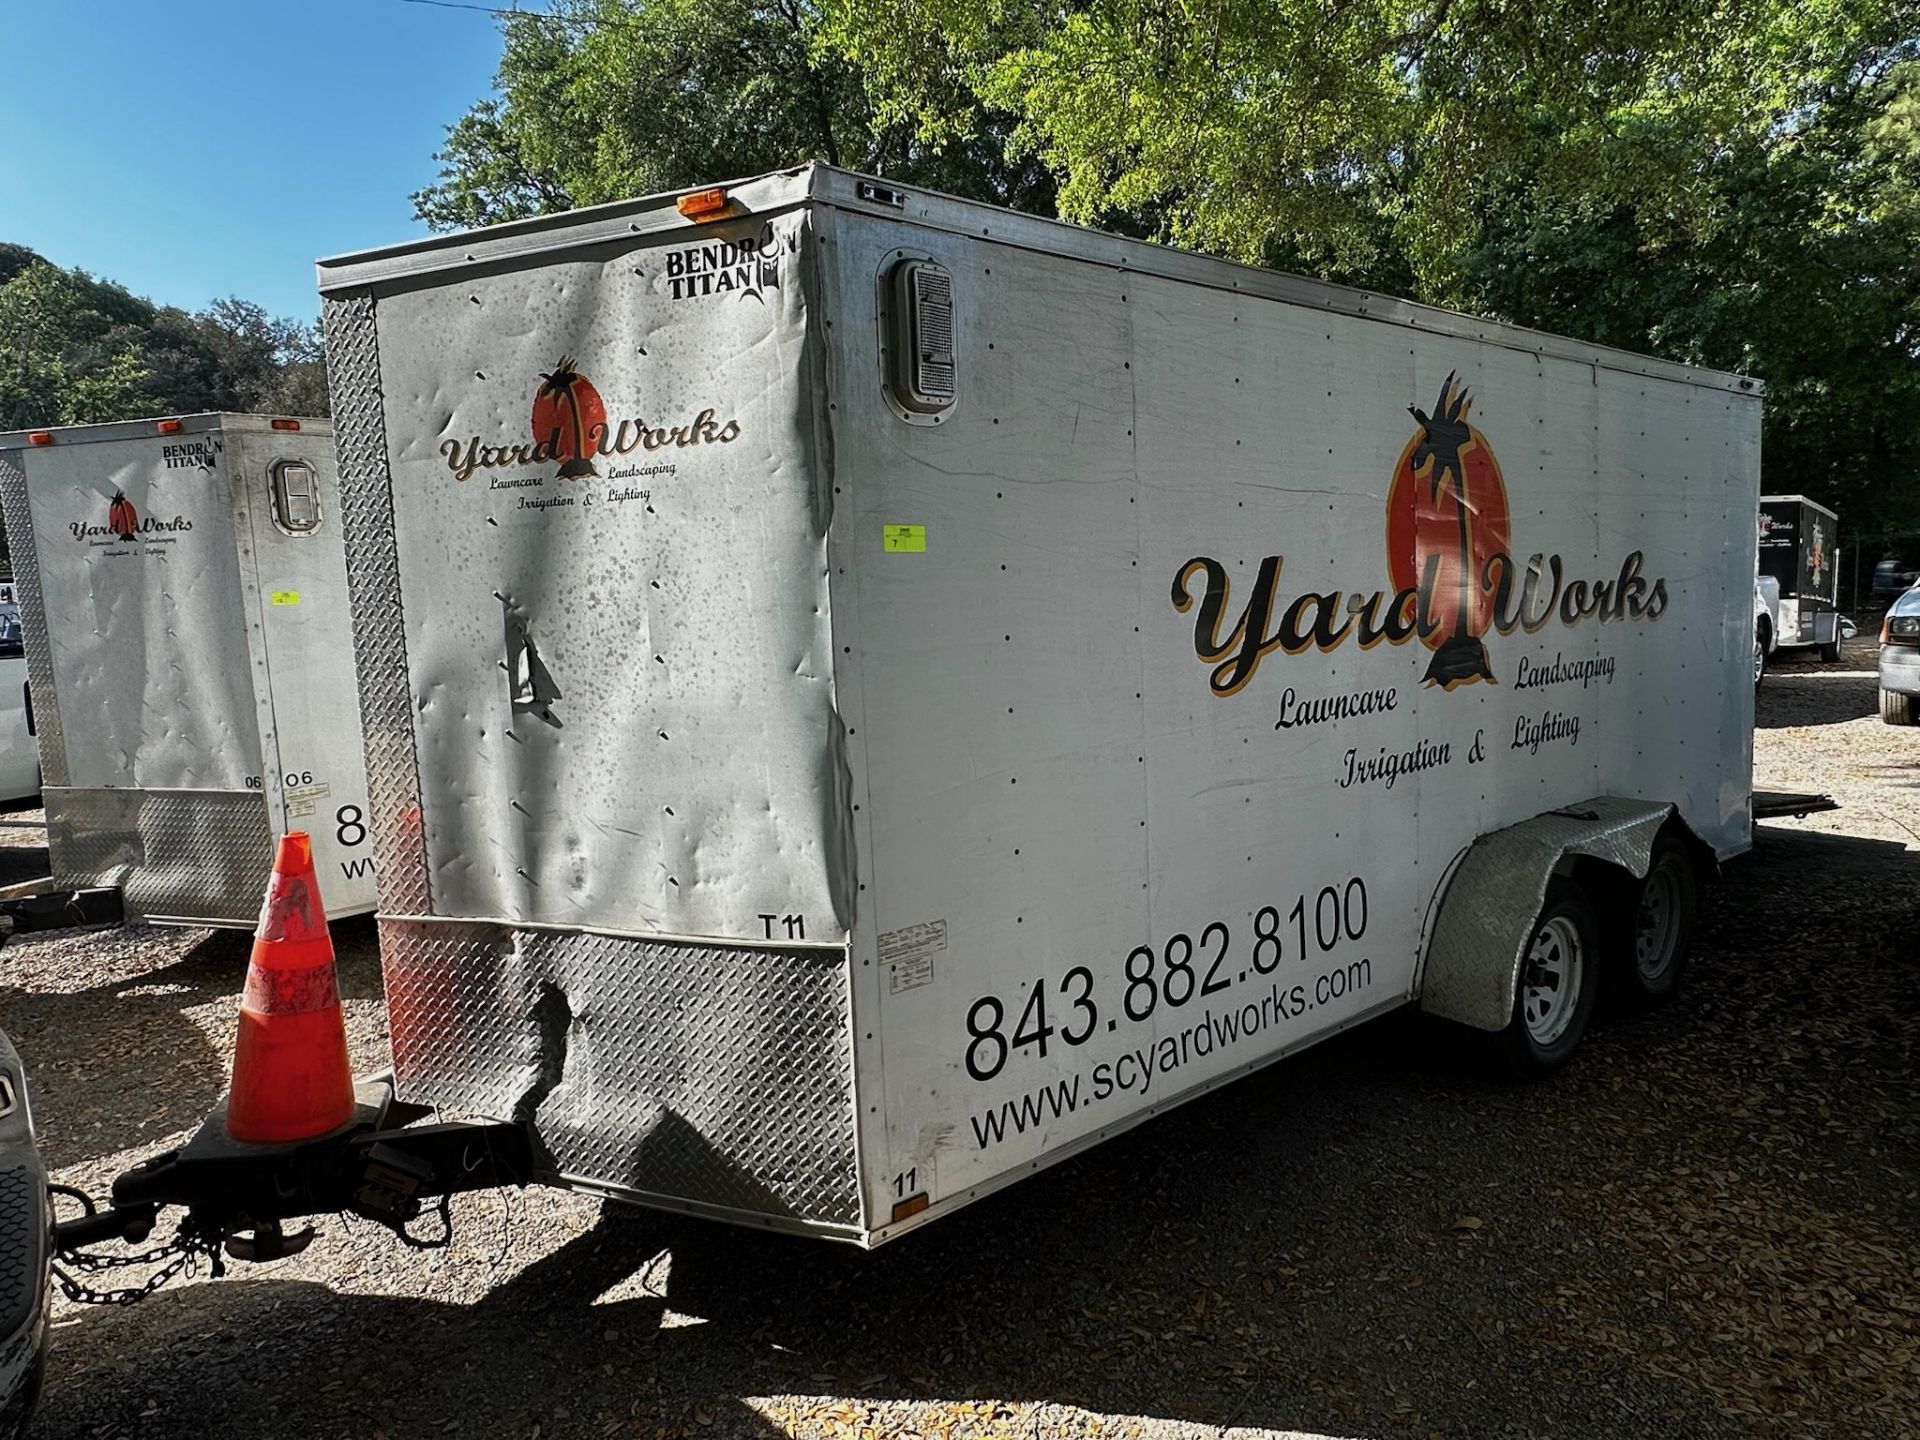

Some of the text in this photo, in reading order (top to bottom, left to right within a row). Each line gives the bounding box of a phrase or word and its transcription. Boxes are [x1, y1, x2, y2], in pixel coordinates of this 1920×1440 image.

[668, 265, 752, 299] TITAN
[440, 408, 742, 481] Yard Works
[165, 456, 202, 468] TITAN
[489, 462, 676, 490] Lawncare Landscaping
[517, 488, 651, 510] Irrigation & Lighting
[69, 515, 193, 541] Yard Works
[1170, 549, 1670, 697] Yard Works
[1274, 652, 1616, 731] Lawncare Landscaping
[1340, 711, 1580, 790] Irrigation & Lighting
[245, 776, 262, 788] 06
[964, 876, 1369, 1082] 843.882.8100
[970, 958, 1372, 1150] www.scyardworks.com
[892, 1167, 917, 1198] 11
